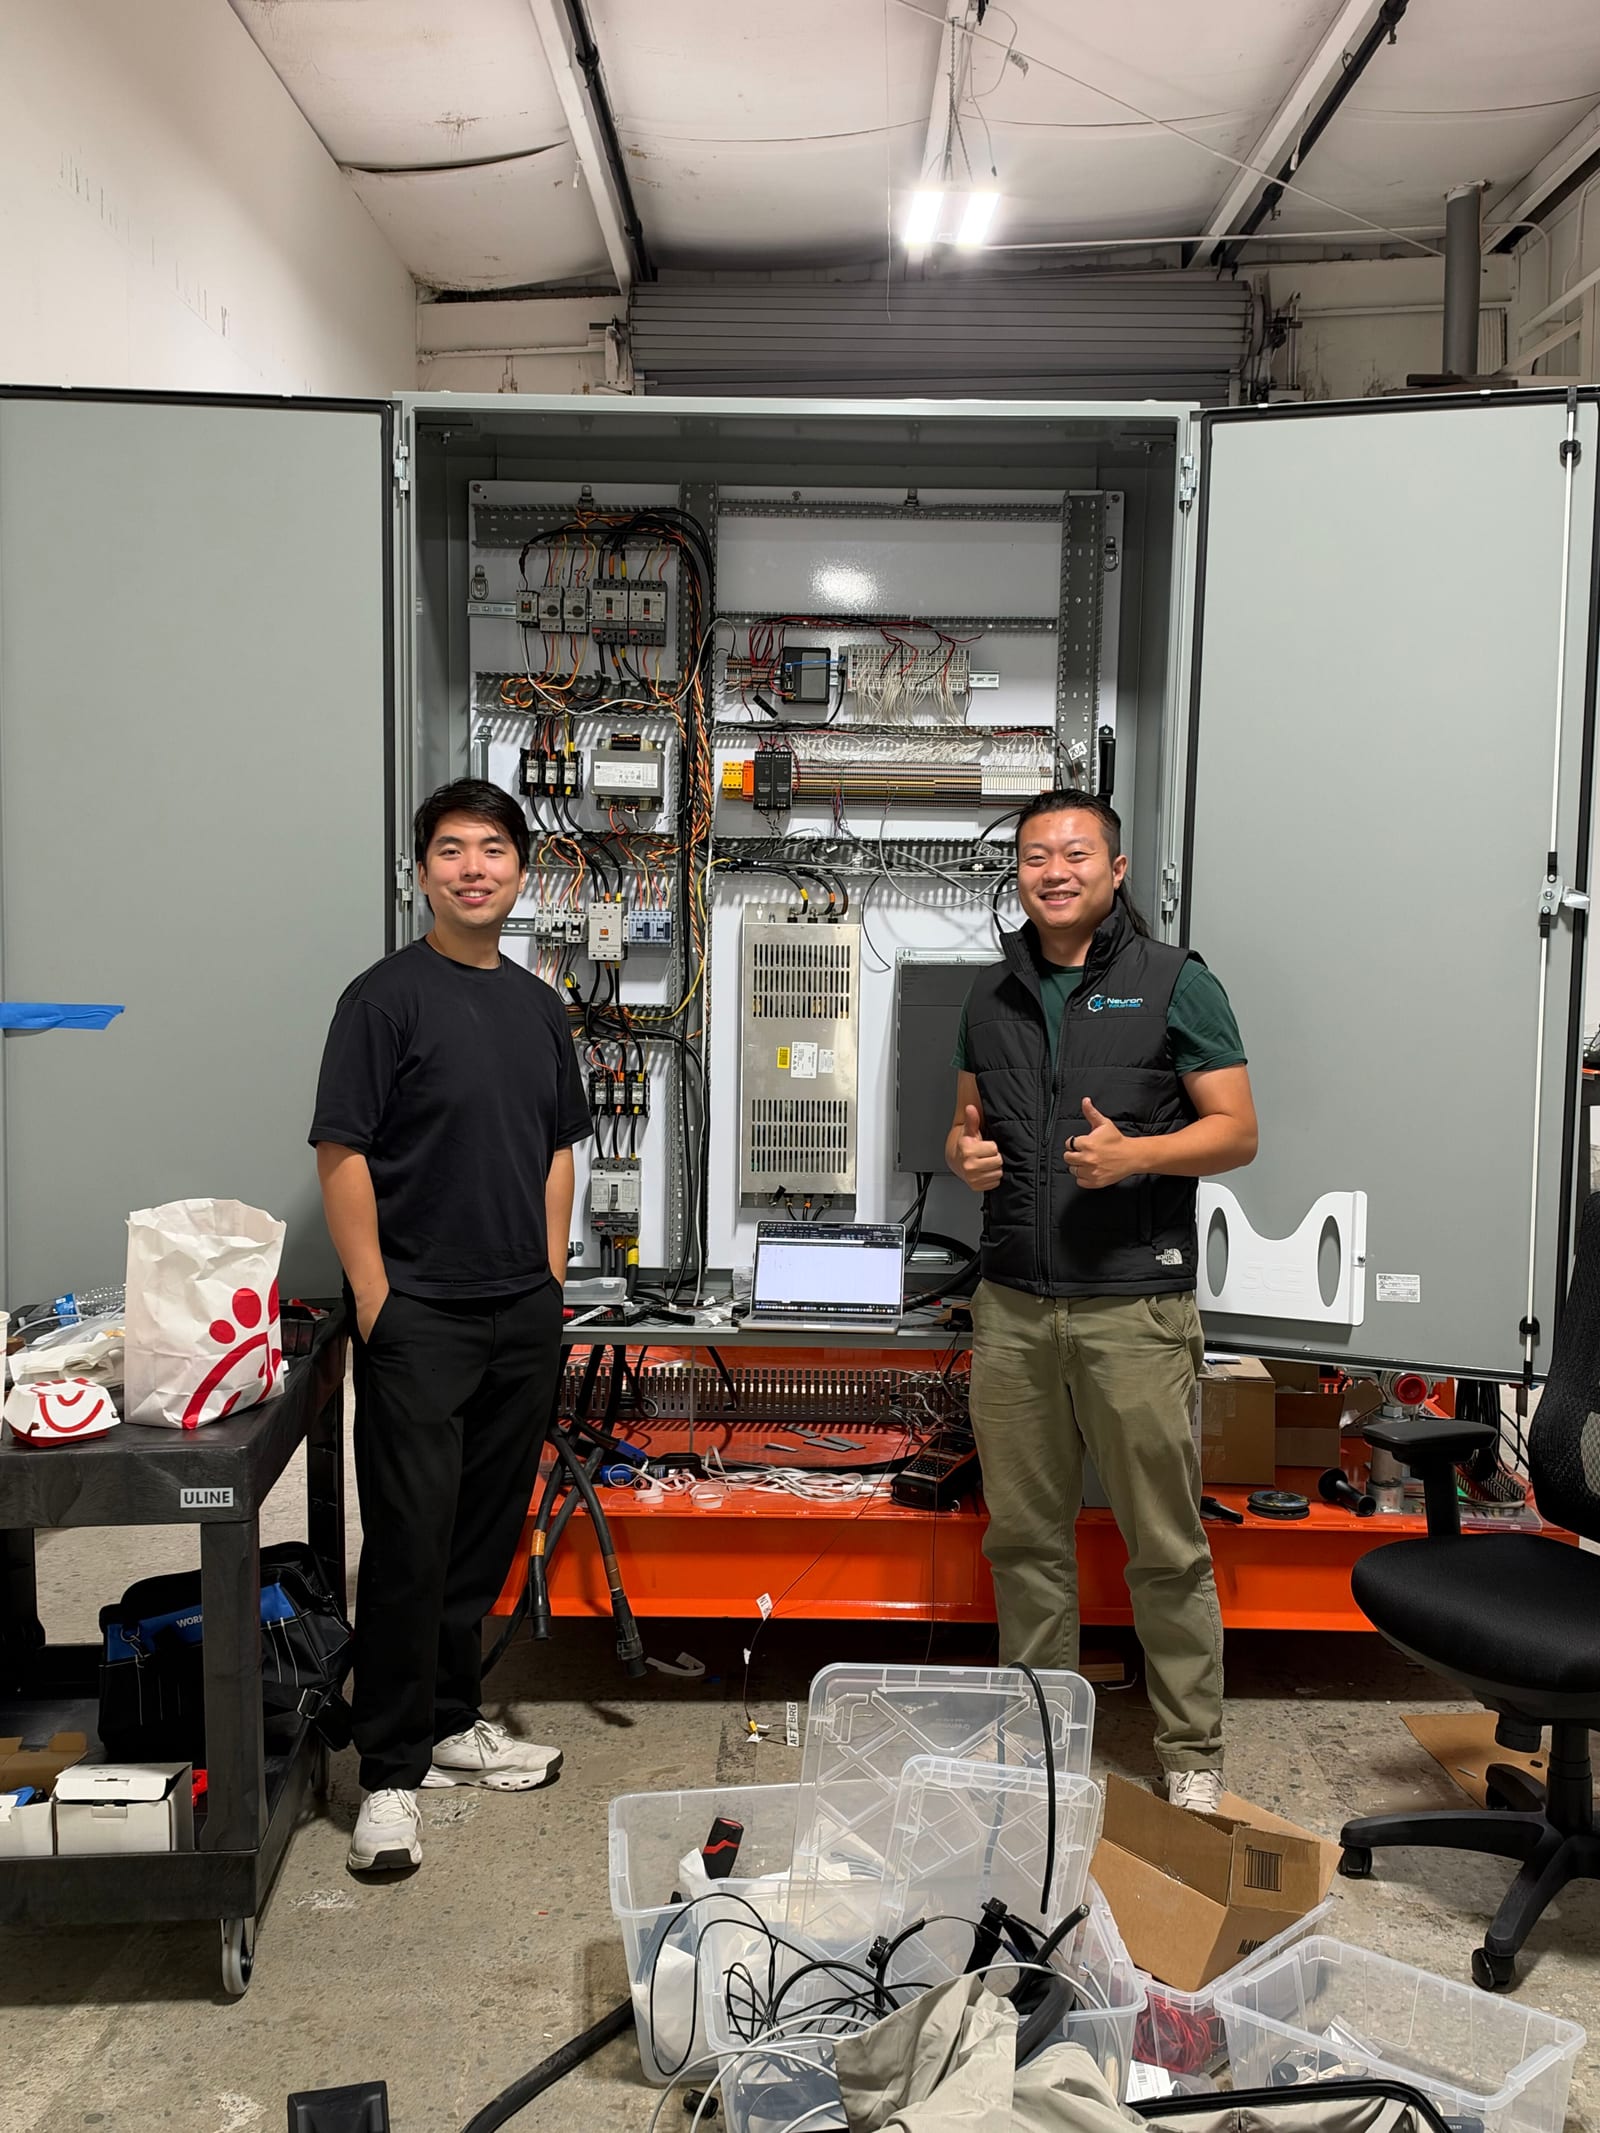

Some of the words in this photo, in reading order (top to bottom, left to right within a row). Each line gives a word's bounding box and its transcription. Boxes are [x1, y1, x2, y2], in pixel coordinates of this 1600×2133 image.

[1106, 997, 1144, 1005] Neuron
[184, 1491, 230, 1504] ULINE
[788, 1704, 797, 1723] BRG
[788, 1727, 798, 1746] AFT
